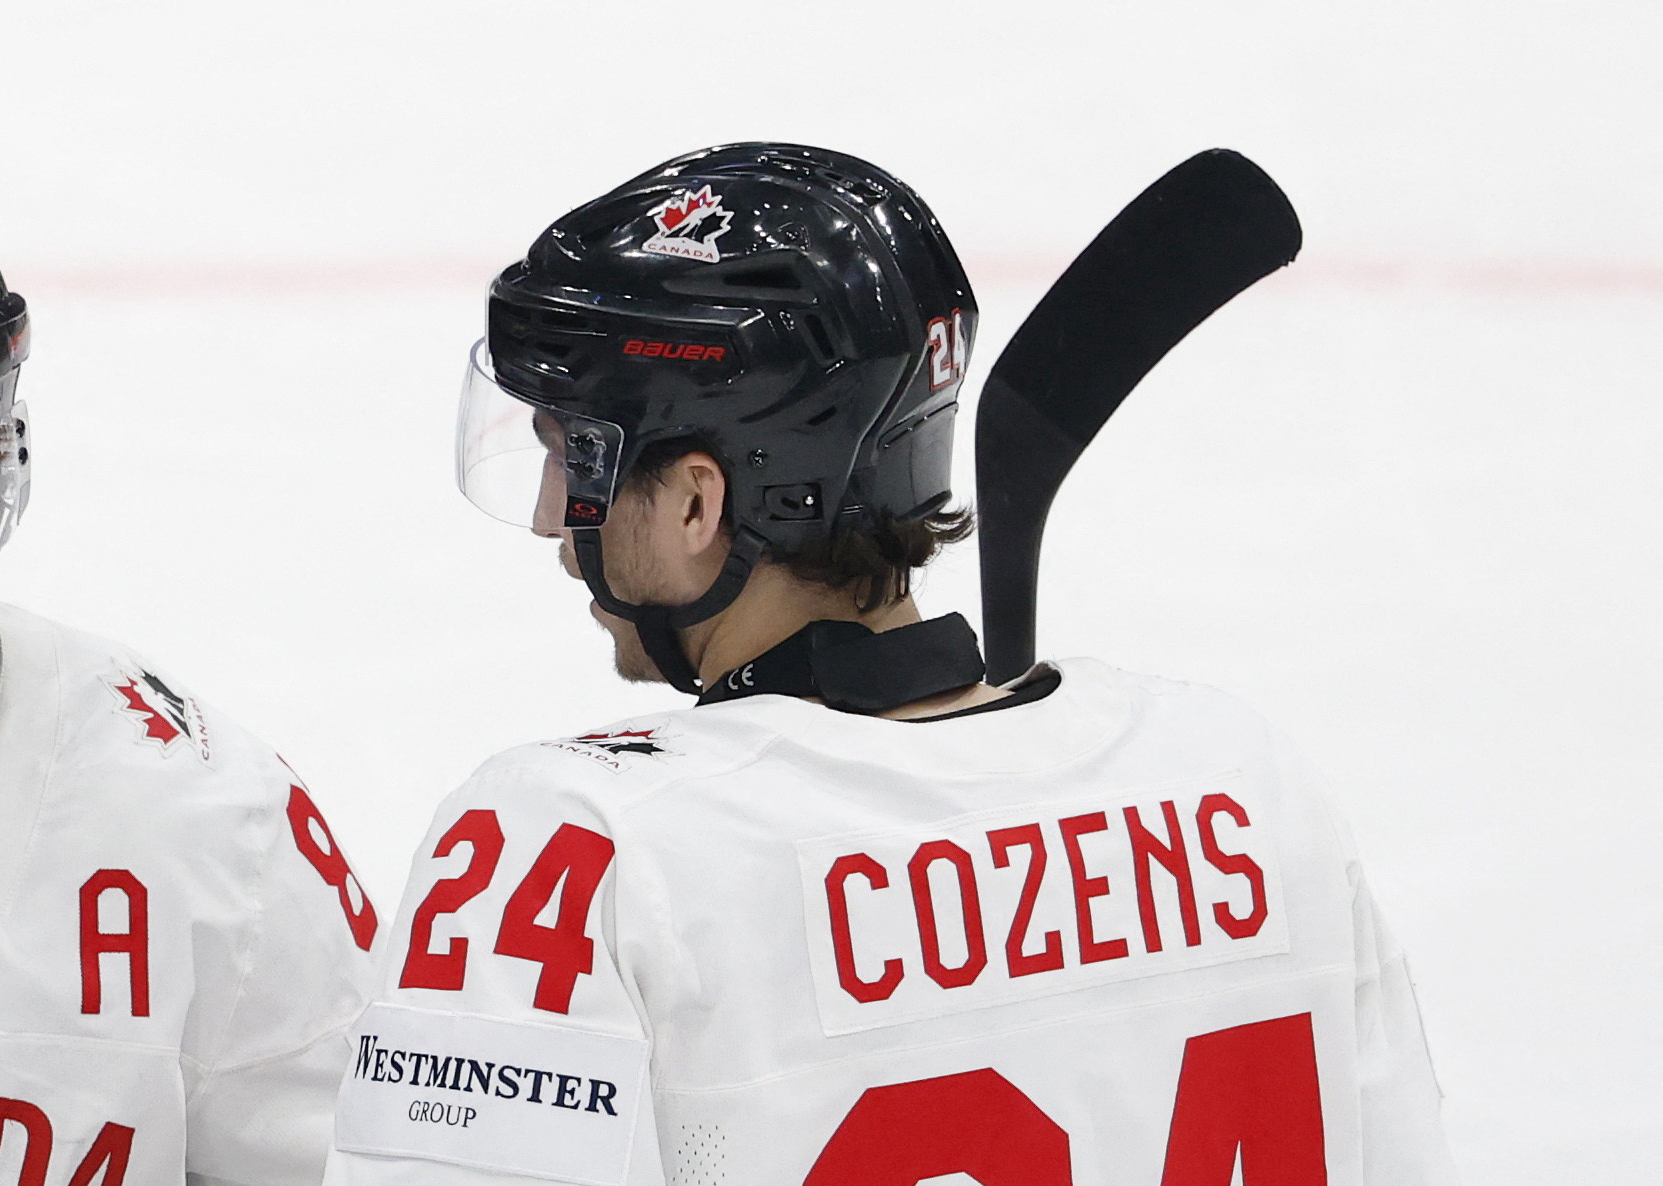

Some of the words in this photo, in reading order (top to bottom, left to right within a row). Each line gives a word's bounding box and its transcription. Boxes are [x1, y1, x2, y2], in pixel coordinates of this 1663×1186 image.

[647, 241, 716, 261] CANADA
[623, 340, 726, 363] BAUER
[728, 663, 755, 691] CE
[398, 809, 615, 1015] 24
[824, 792, 1268, 1004] COZENS
[79, 868, 150, 1017] A
[353, 1034, 619, 1117] WESTMINSTER
[408, 1099, 477, 1129] GROUP
